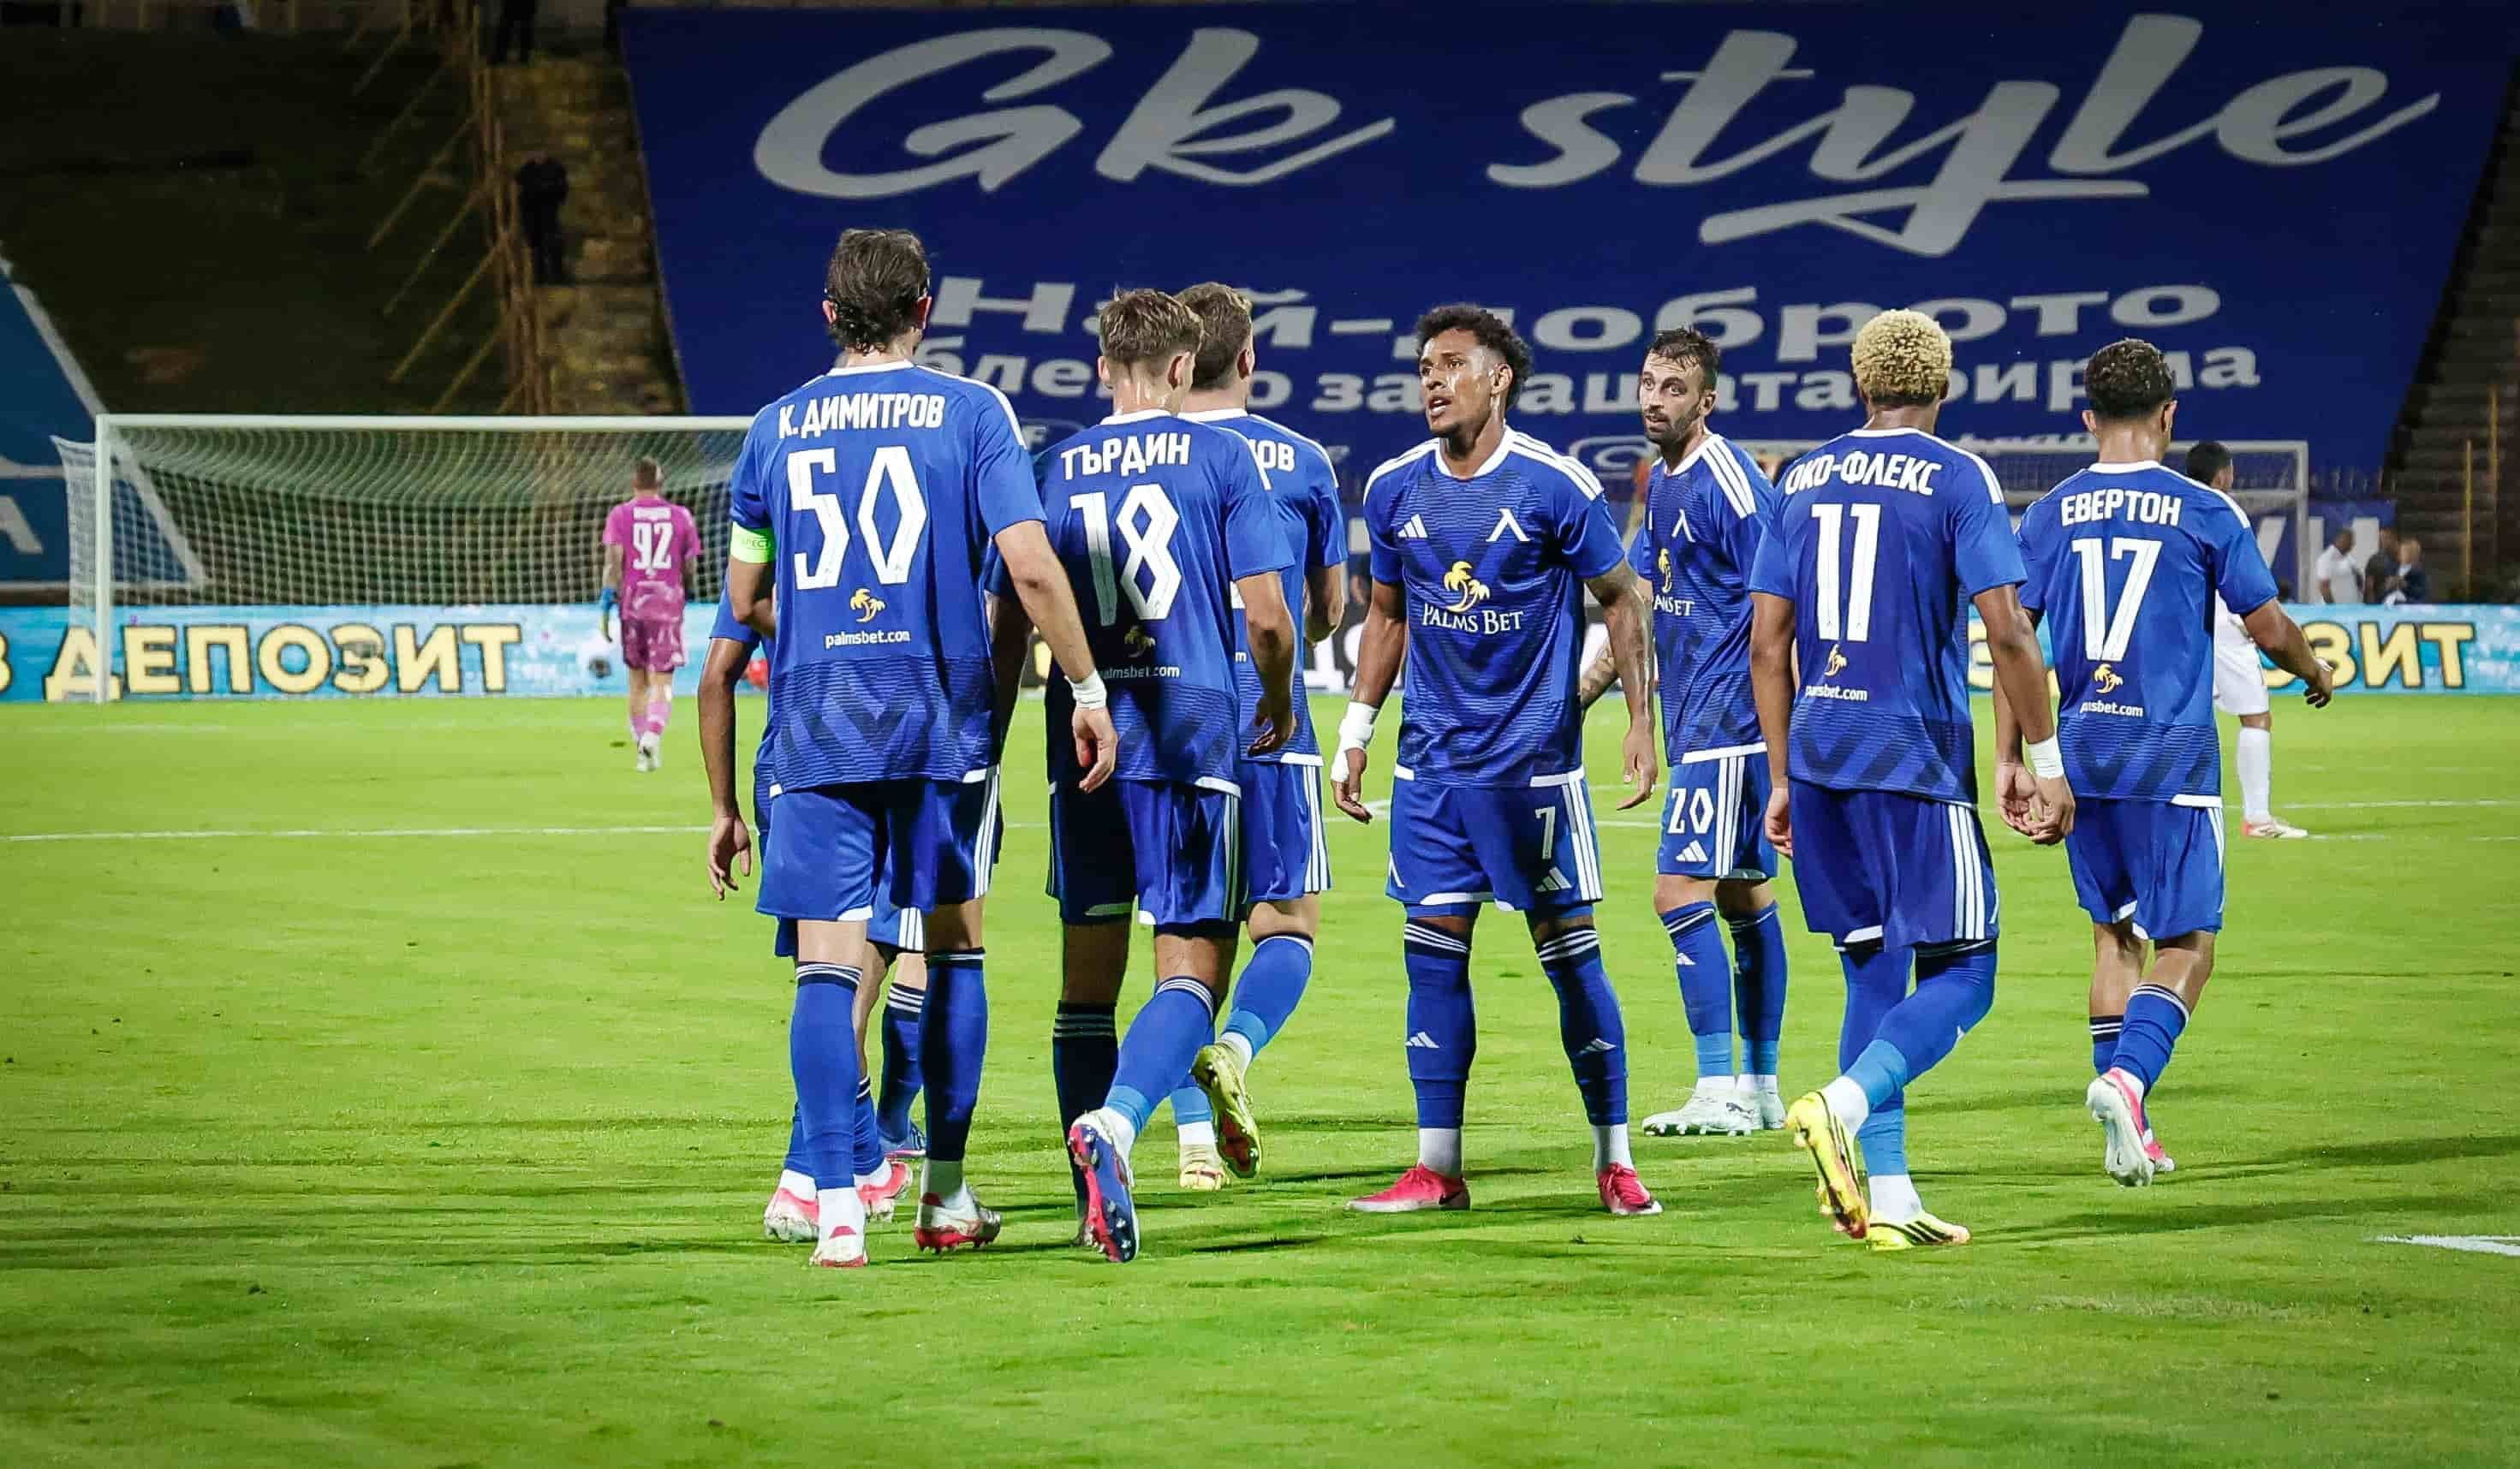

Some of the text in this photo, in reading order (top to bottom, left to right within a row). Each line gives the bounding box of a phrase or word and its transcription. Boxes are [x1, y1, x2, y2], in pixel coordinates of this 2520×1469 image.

[754, 14, 2440, 257] Gk style
[931, 276, 2221, 363] Нй-оброто
[778, 392, 945, 439] К.ДИМИТРОВ
[1310, 372, 1425, 413] за
[1060, 432, 1191, 481] ТЪРДИН
[1784, 450, 1942, 496] ОКО-ФЛЕКС
[786, 444, 926, 591] 50
[2061, 487, 2183, 527] ЕВЕРТОН
[633, 522, 673, 569] 92
[1069, 483, 1183, 626] 18
[1811, 503, 1881, 642] 11
[1422, 603, 1523, 634] PALMS BET
[2070, 537, 2163, 663] 17
[45, 622, 521, 702] ДЕПОЗИТ
[1099, 665, 1180, 680] almsbet.com
[1534, 806, 1556, 859] 7
[1667, 787, 1714, 835] 20
